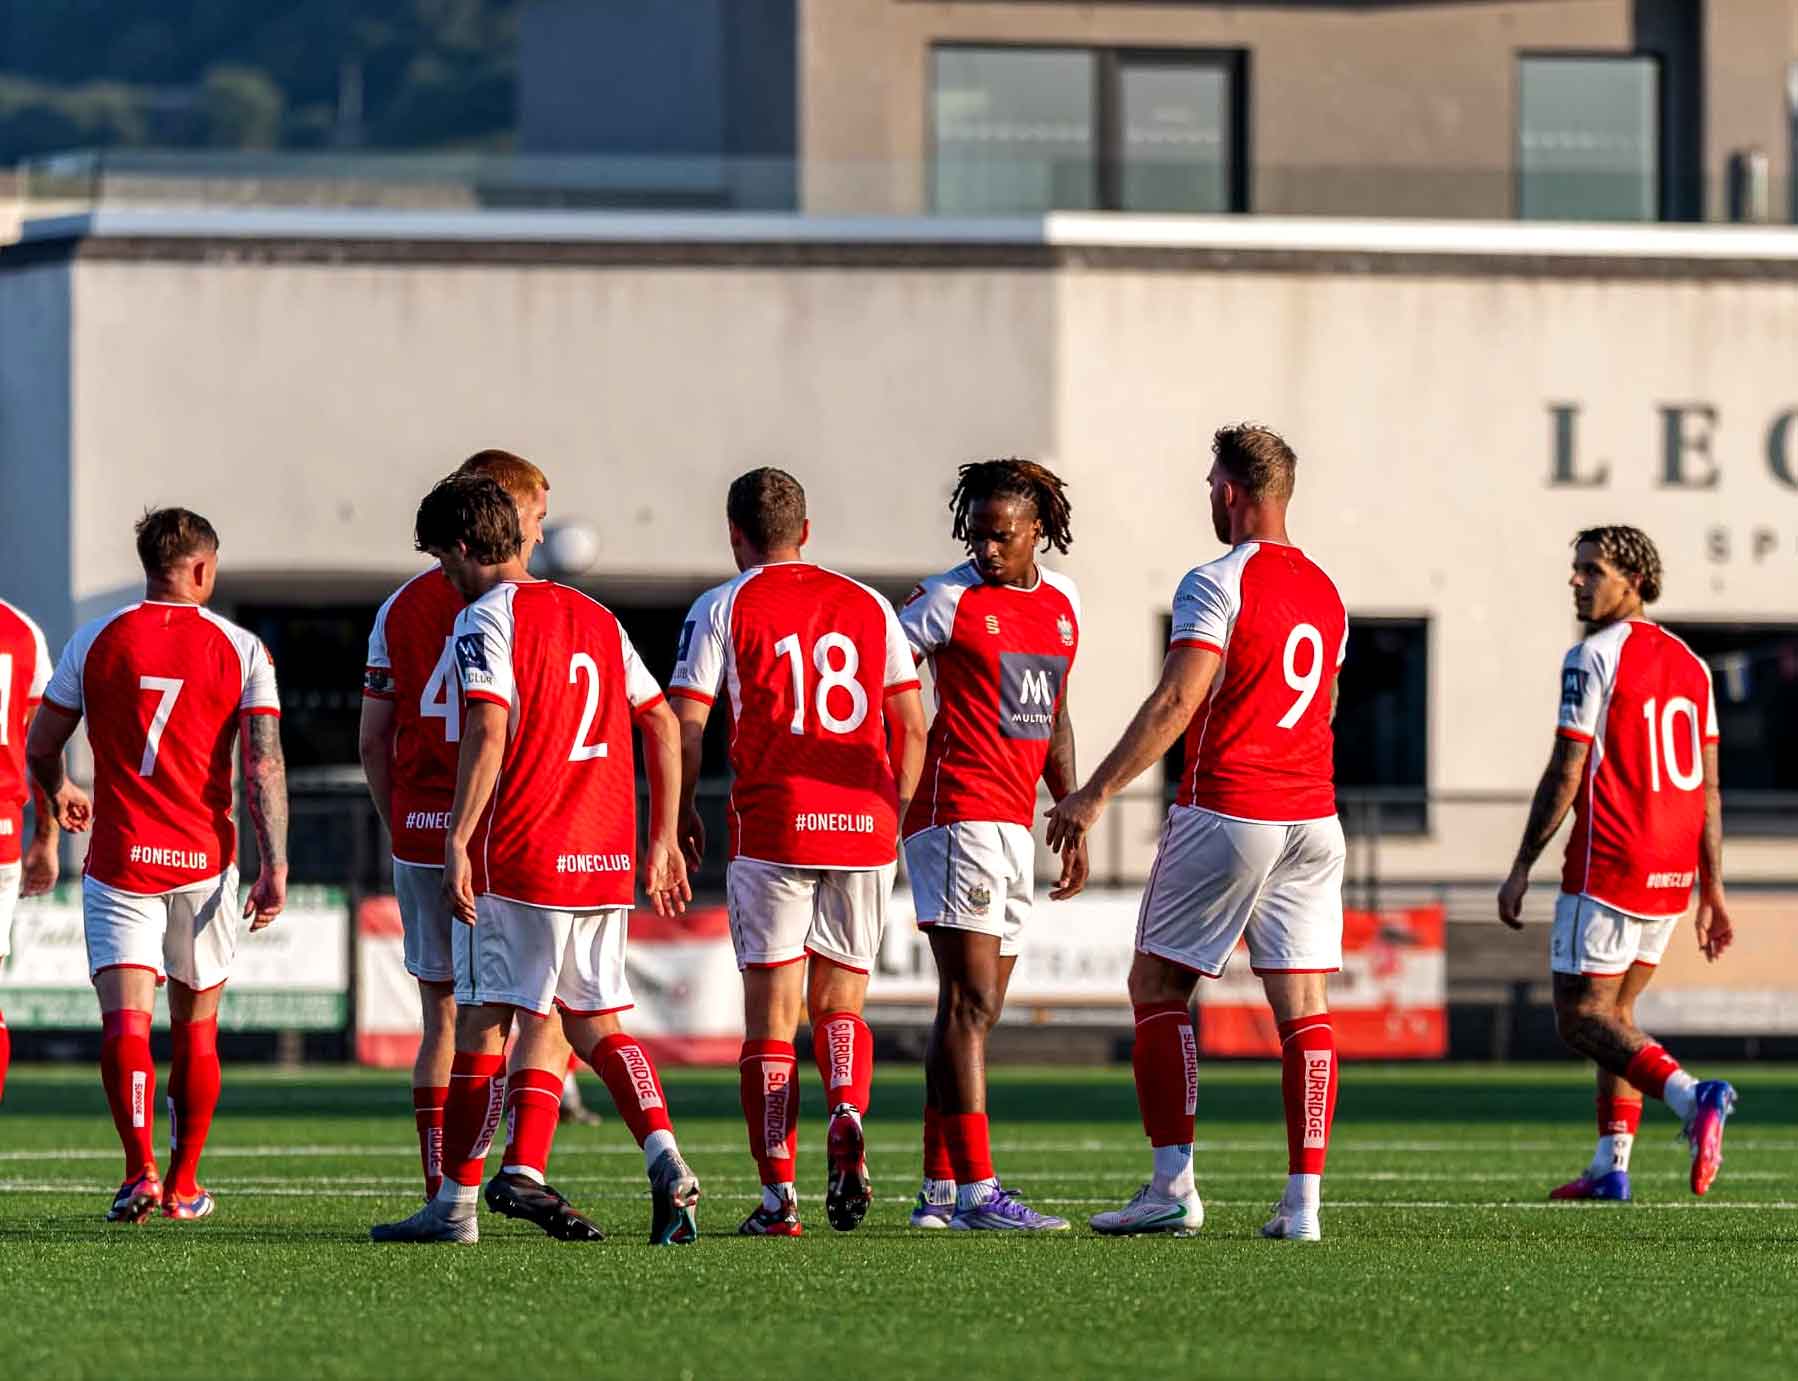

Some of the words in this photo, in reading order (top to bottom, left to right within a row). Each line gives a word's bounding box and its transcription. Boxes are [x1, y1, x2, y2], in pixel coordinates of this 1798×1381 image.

[420, 636, 460, 742] 4
[568, 652, 608, 762] 2
[774, 632, 868, 735] 18
[1276, 623, 1323, 730] 9
[139, 675, 184, 777] 7
[1643, 697, 1703, 792] 10
[130, 845, 208, 870] #ONECLUB
[555, 853, 631, 873] #ONECLUB
[795, 812, 875, 833] #ONECLUB
[831, 1022, 851, 1079] SURRIDGE
[1183, 1032, 1198, 1105] SURRIDGE
[766, 1071, 787, 1150] SURRIDGE
[1307, 1058, 1328, 1140] SURRIDGE
